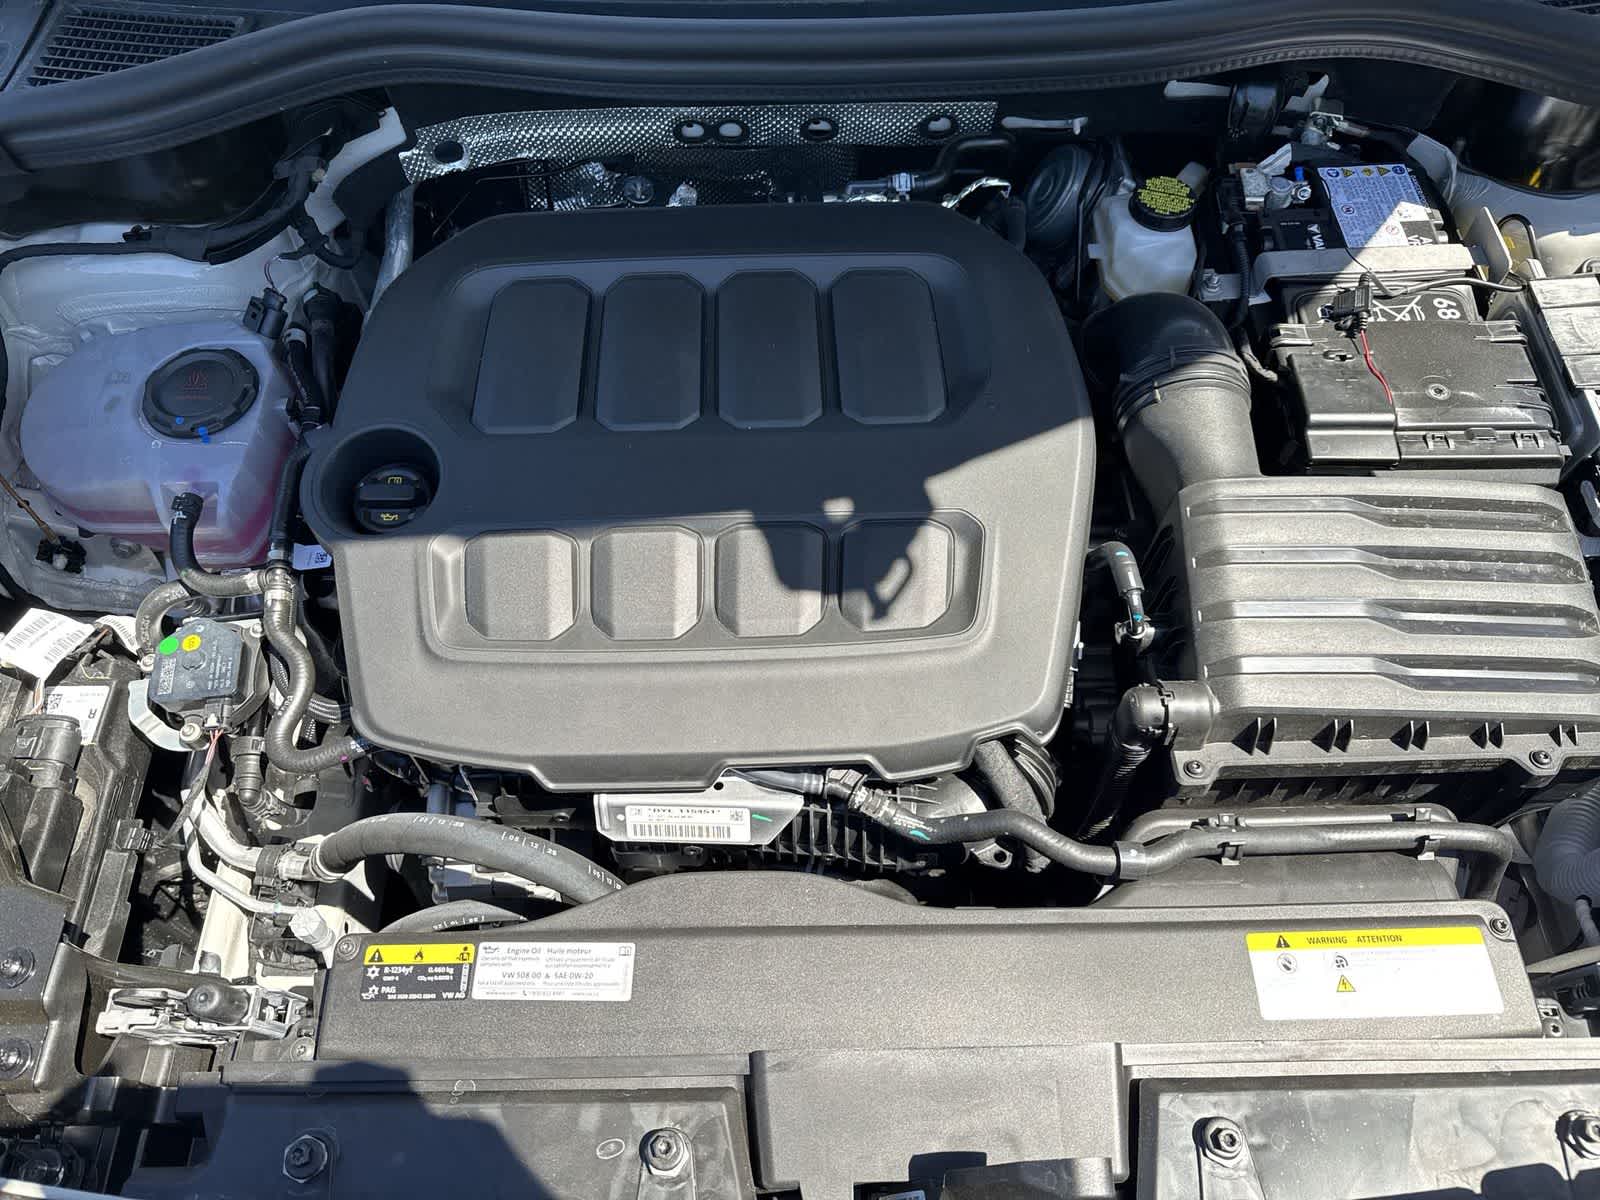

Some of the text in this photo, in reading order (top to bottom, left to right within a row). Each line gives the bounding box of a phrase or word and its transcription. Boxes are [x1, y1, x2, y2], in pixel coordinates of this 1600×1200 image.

[1306, 934, 1402, 945] WARNING ATTENTION
[507, 947, 529, 955] Engine
[383, 966, 413, 975] R-1234yf
[517, 971, 529, 979] 508
[531, 971, 541, 979] 00
[554, 971, 566, 979] SAE
